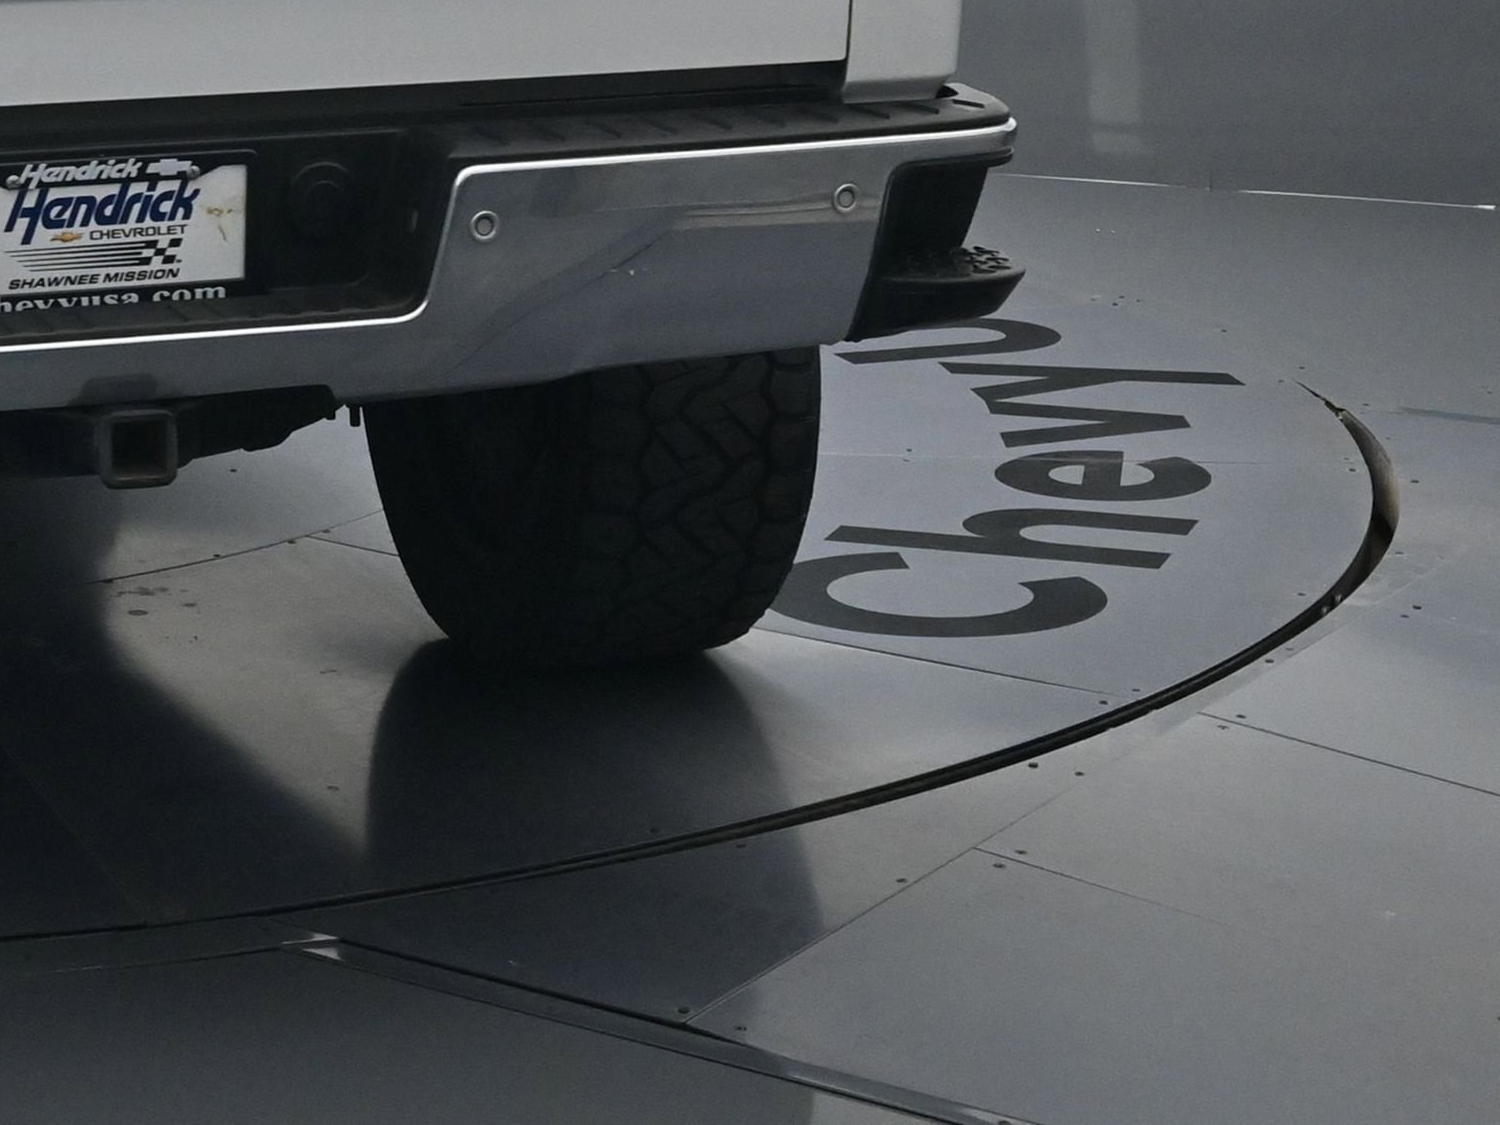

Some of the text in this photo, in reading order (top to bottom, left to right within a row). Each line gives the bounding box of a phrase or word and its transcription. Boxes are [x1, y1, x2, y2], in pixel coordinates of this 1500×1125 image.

[18, 158, 143, 189] Hendrick
[4, 181, 201, 245] Hendrick
[89, 224, 188, 241] CHEVROLET
[8, 268, 180, 290] SHAWNEE MISSION
